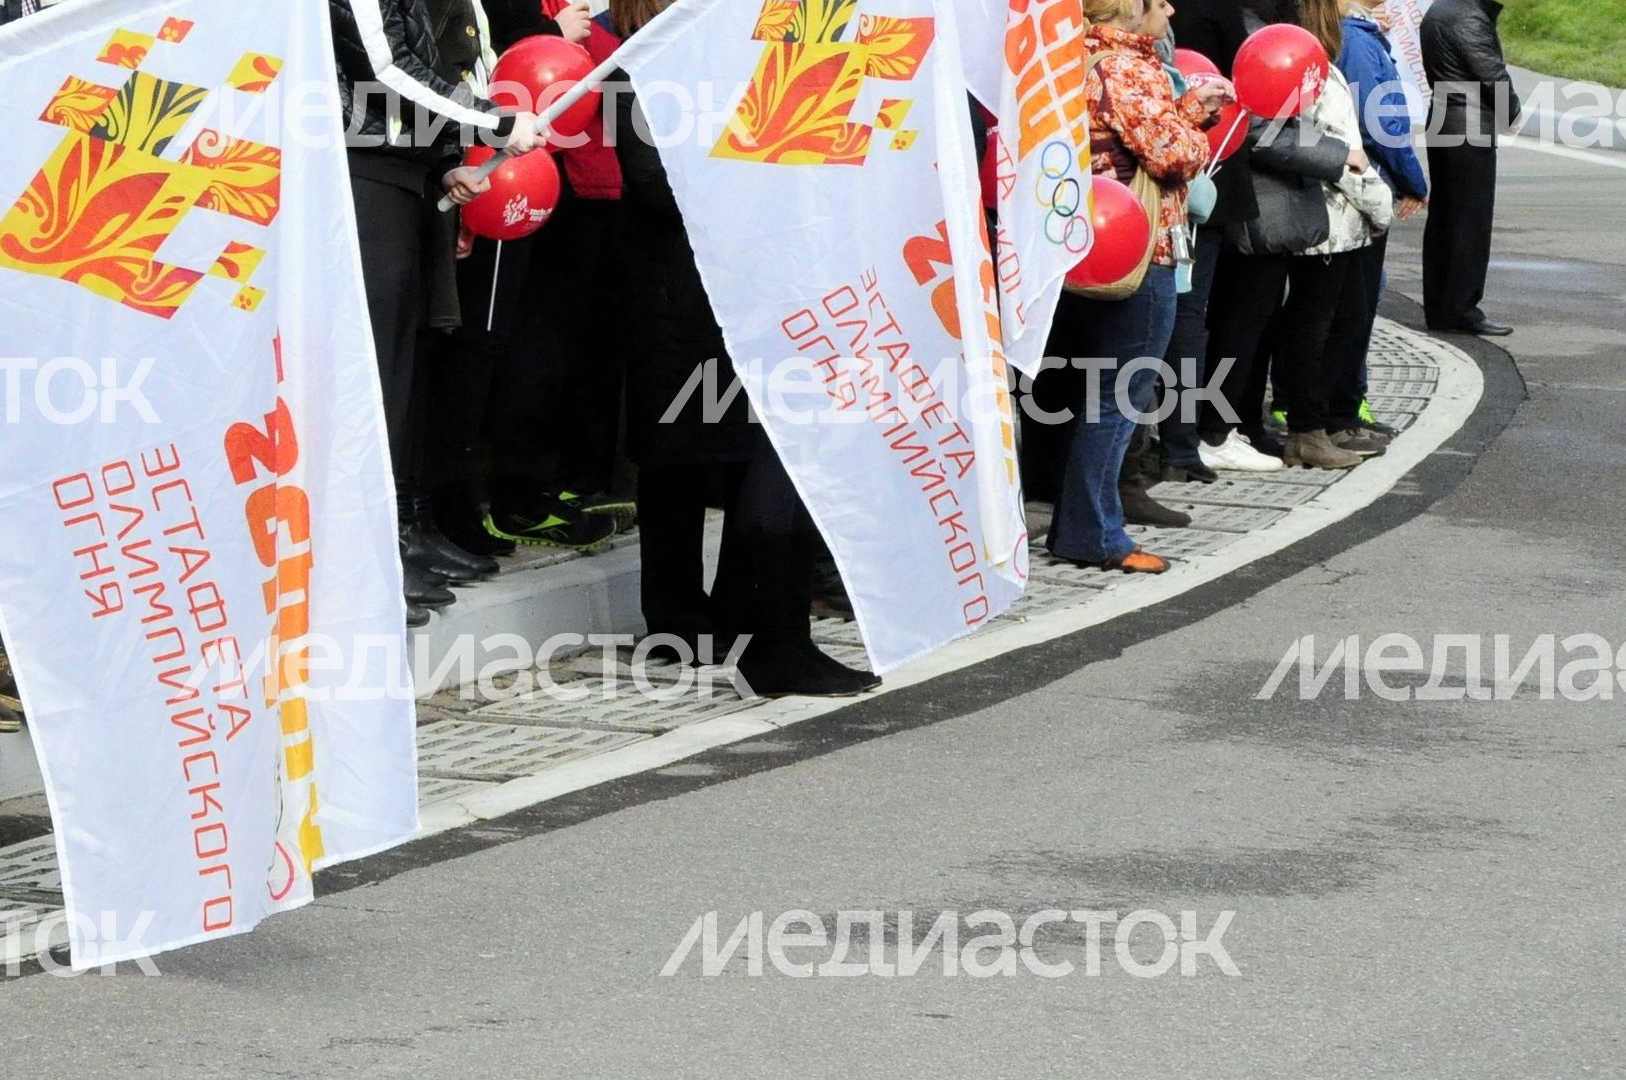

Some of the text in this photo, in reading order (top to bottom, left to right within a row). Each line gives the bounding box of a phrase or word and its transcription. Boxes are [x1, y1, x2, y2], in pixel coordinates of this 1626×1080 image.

[780, 308, 858, 412] ОГНЯ
[822, 284, 989, 626] ОЛИМПИЙСКОГО
[860, 264, 976, 479] ЭСТАФЕТА
[52, 471, 125, 619] ОГНЯ
[140, 442, 253, 742] ЭСТАФЕТА
[100, 458, 234, 933] ОЛИМПИЙСКОГО
